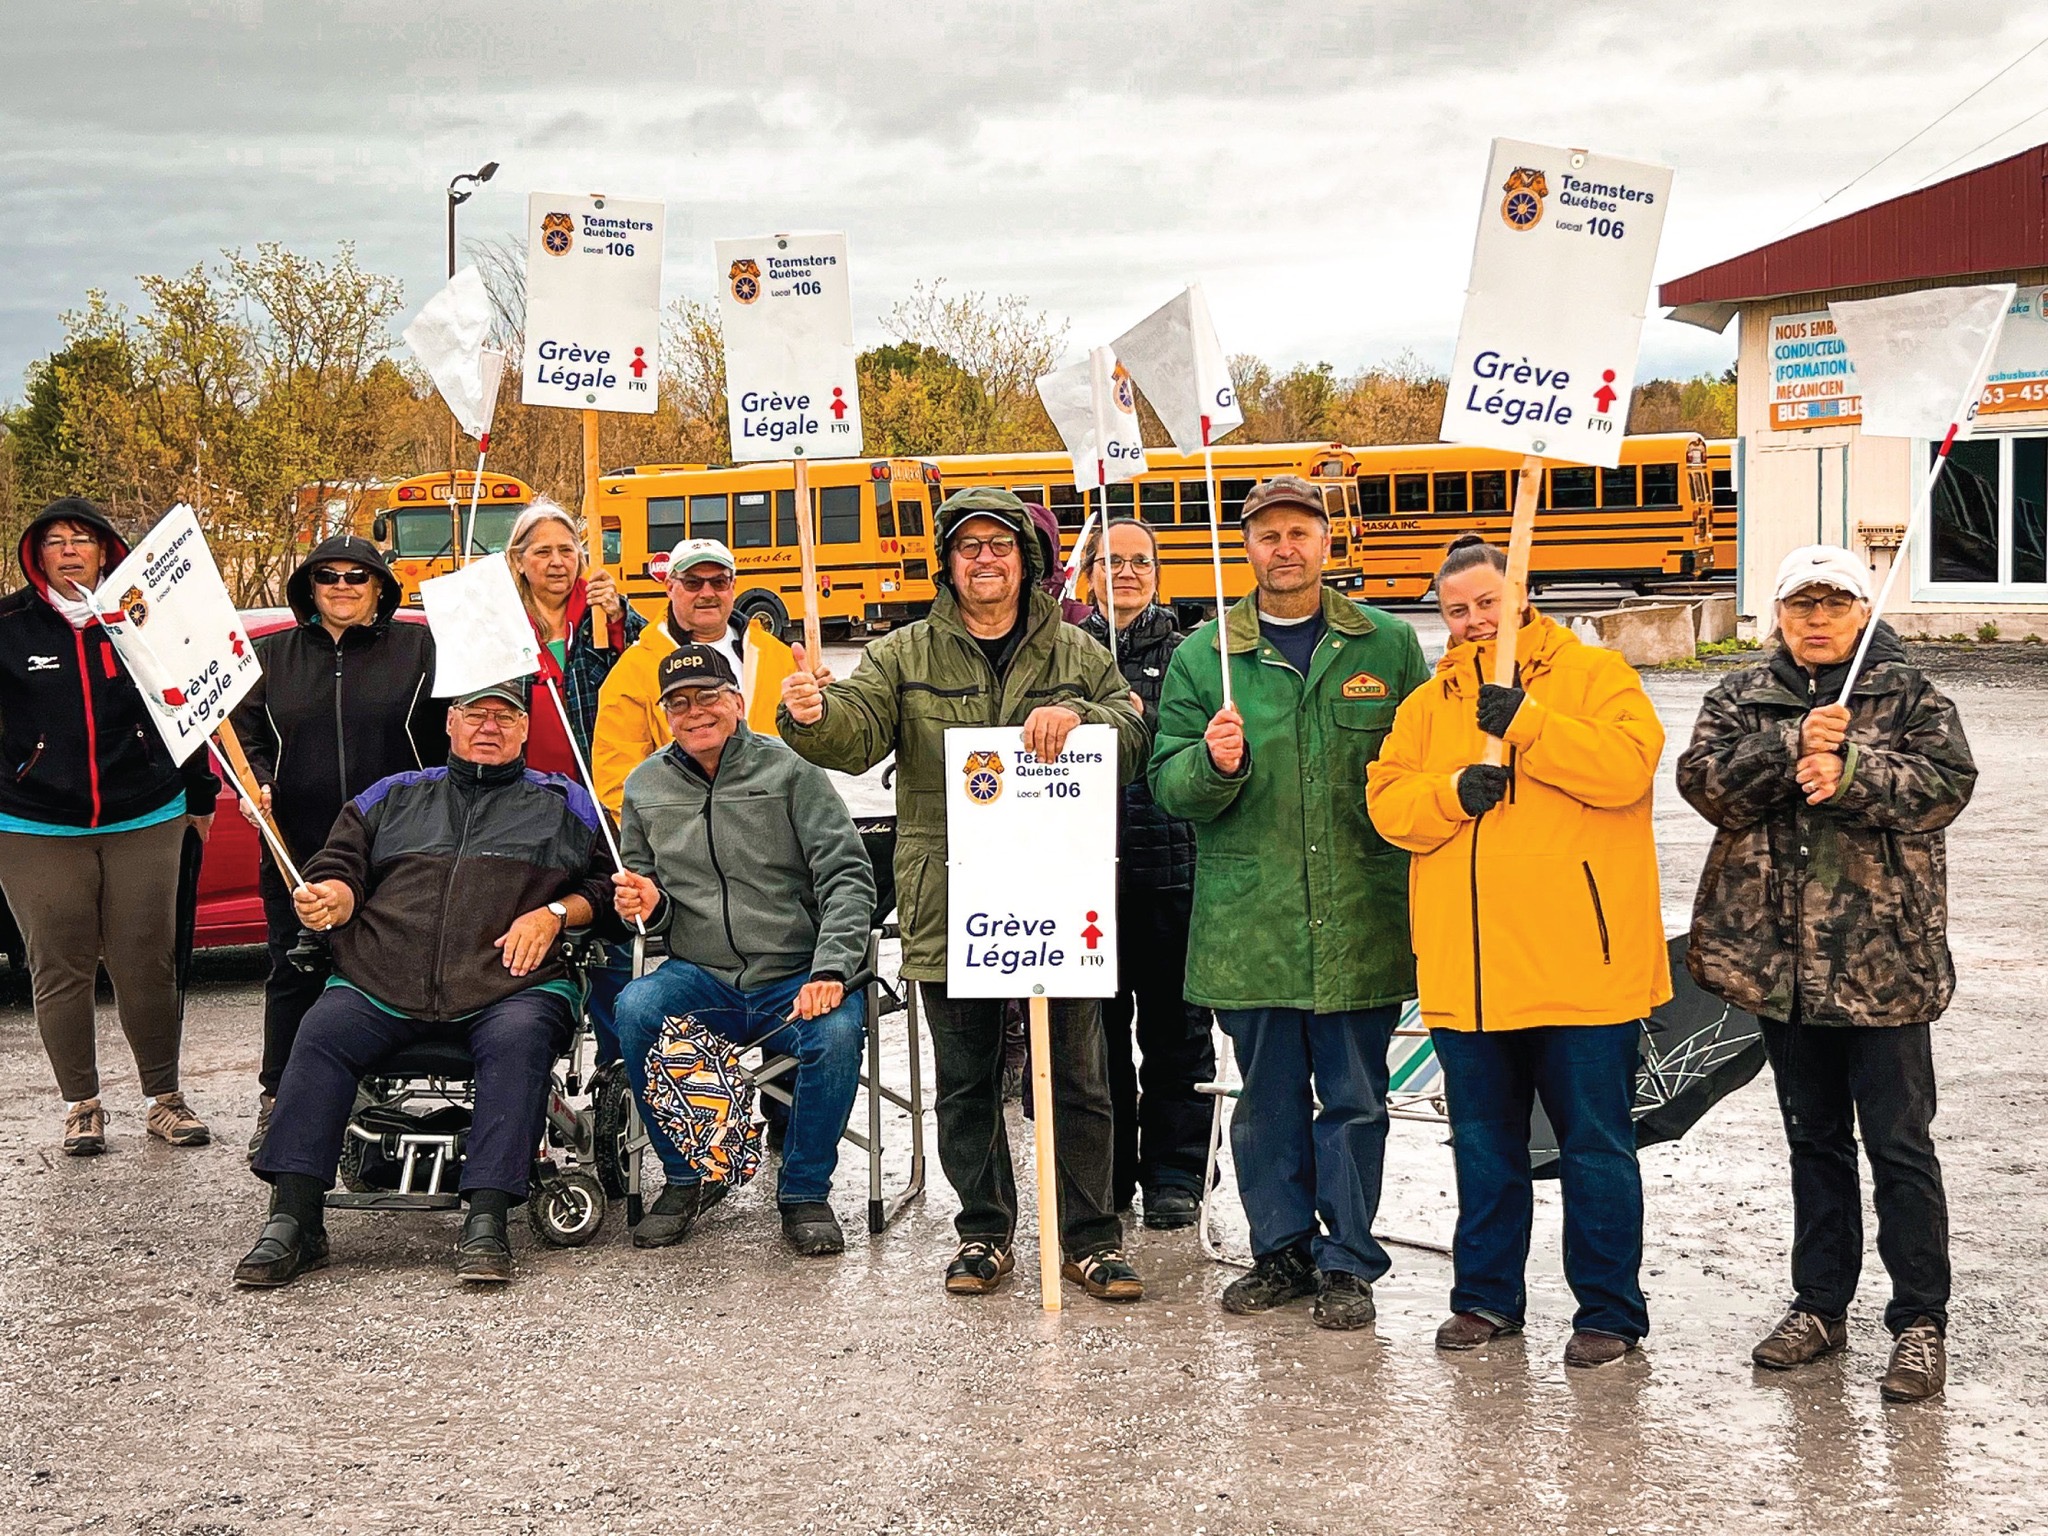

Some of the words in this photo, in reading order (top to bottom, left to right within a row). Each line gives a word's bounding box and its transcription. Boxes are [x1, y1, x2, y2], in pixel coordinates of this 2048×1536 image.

[1561, 174, 1654, 204] Teamsters
[1559, 191, 1617, 213] Québec
[582, 214, 653, 232] Teamsters
[583, 227, 627, 239] Québec
[1555, 220, 1583, 232] Local
[1586, 216, 1625, 240] 106
[606, 242, 635, 257] 106
[766, 254, 837, 269] Teamsters
[768, 268, 812, 280] Québec
[771, 289, 791, 298] Local
[793, 280, 822, 296] 106
[1775, 322, 1807, 341] NOUS
[1810, 319, 1837, 337] EMB
[538, 340, 611, 365] Grève
[537, 363, 617, 392] Légale
[1472, 350, 1570, 390] Grève
[1776, 358, 1847, 382] (FORMATION
[628, 380, 648, 393] FTQ
[1776, 379, 1844, 400] MÉCANICIEN
[741, 391, 811, 413] Grève
[1465, 384, 1573, 426] Légale
[1777, 397, 1862, 422] BUSBUSBU
[743, 413, 819, 442] Légale
[830, 423, 850, 434] FTQ
[1587, 417, 1613, 434] FTQ
[1401, 520, 1421, 530] INC.
[142, 527, 194, 581] Teamsters
[733, 551, 792, 564] maska
[148, 554, 180, 589] Québec
[169, 558, 192, 585] 106
[665, 655, 704, 674] Jeep
[183, 659, 219, 703] rève
[1013, 750, 1103, 764] Testers
[1015, 765, 1070, 777] Québec
[1016, 790, 1041, 798] Local
[1044, 782, 1081, 798] 106
[965, 912, 1057, 938] Grève
[965, 941, 1065, 975] Légale
[1080, 954, 1104, 967] FTQ
